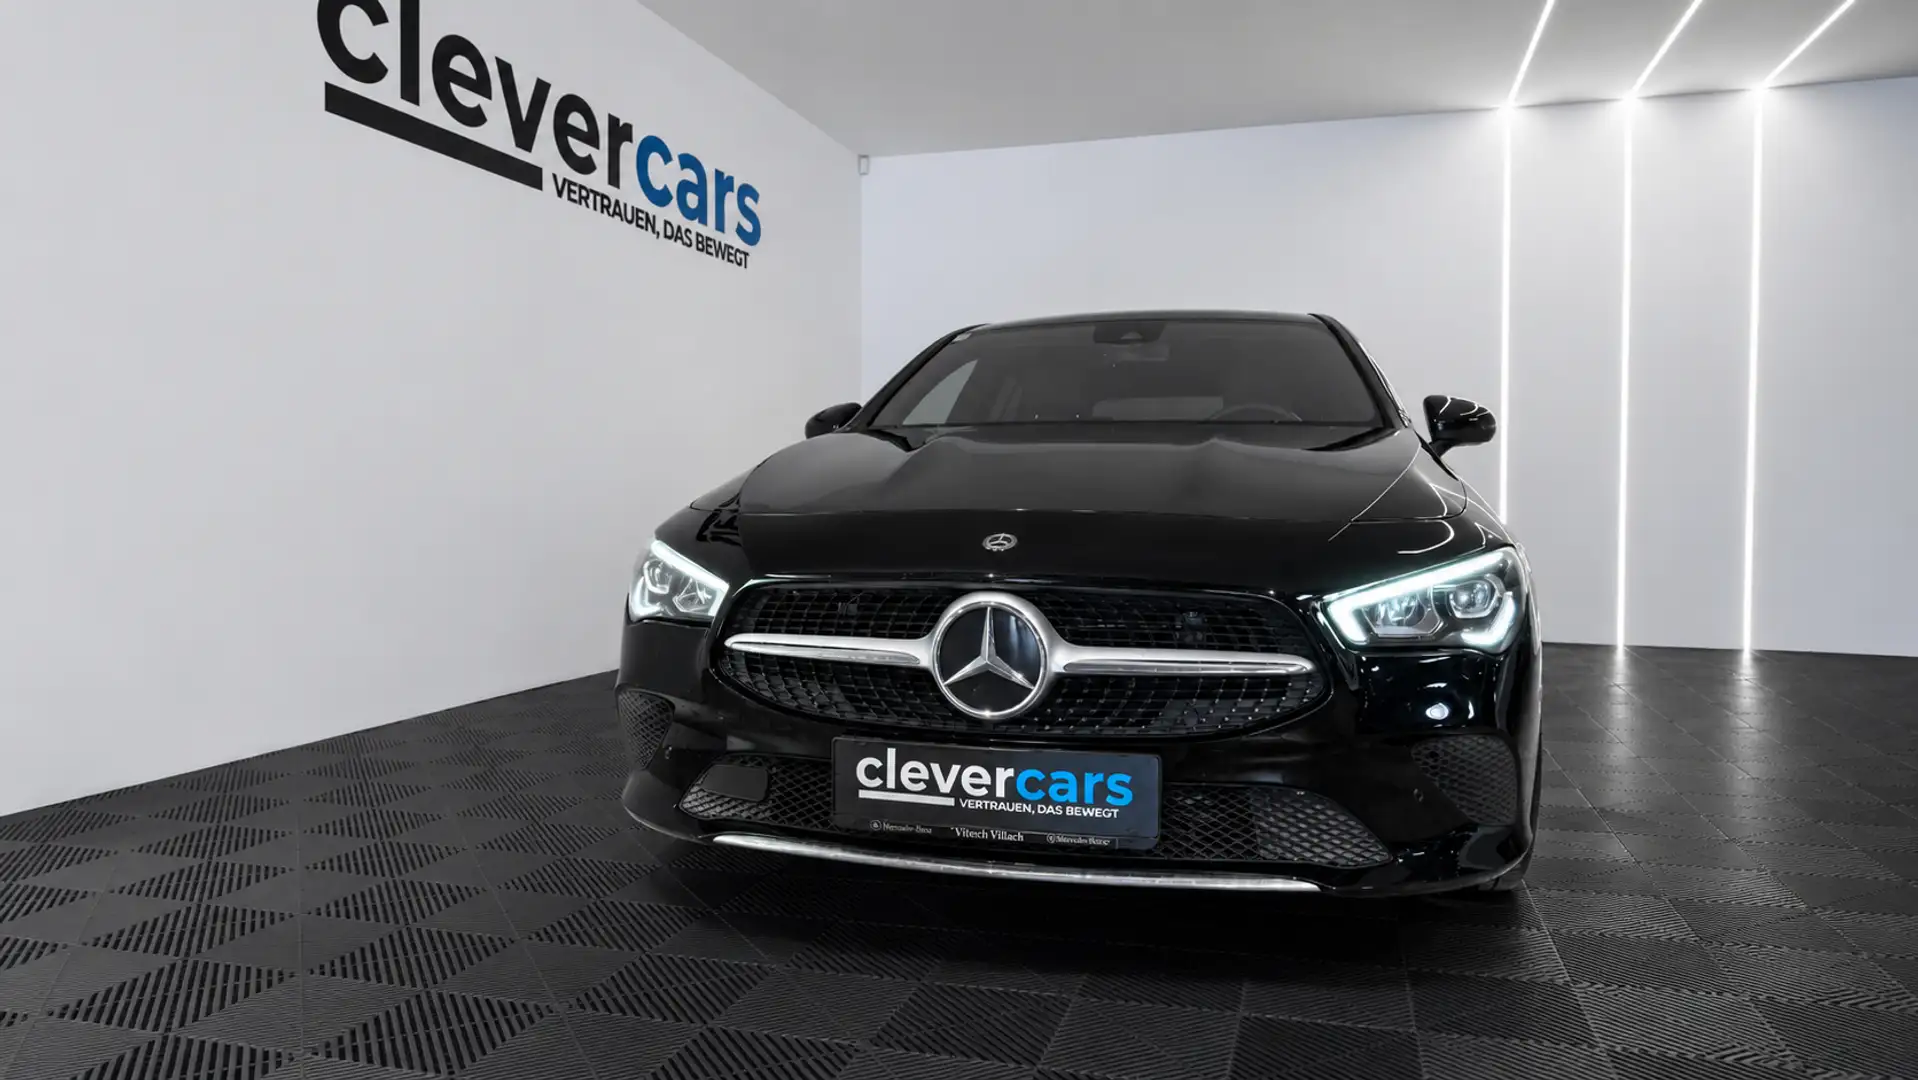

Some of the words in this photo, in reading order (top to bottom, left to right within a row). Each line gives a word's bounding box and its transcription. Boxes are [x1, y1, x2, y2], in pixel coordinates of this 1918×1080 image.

[317, 0, 762, 246] clevercars
[552, 173, 660, 240] VERTRAUEN,
[663, 219, 693, 248] DAS
[696, 231, 750, 269] BEWEGT
[855, 747, 1133, 807] clevercars
[959, 798, 1035, 815] VERTRAUEN,
[1037, 804, 1063, 816] DAS
[1066, 806, 1120, 819] BEWEGT
